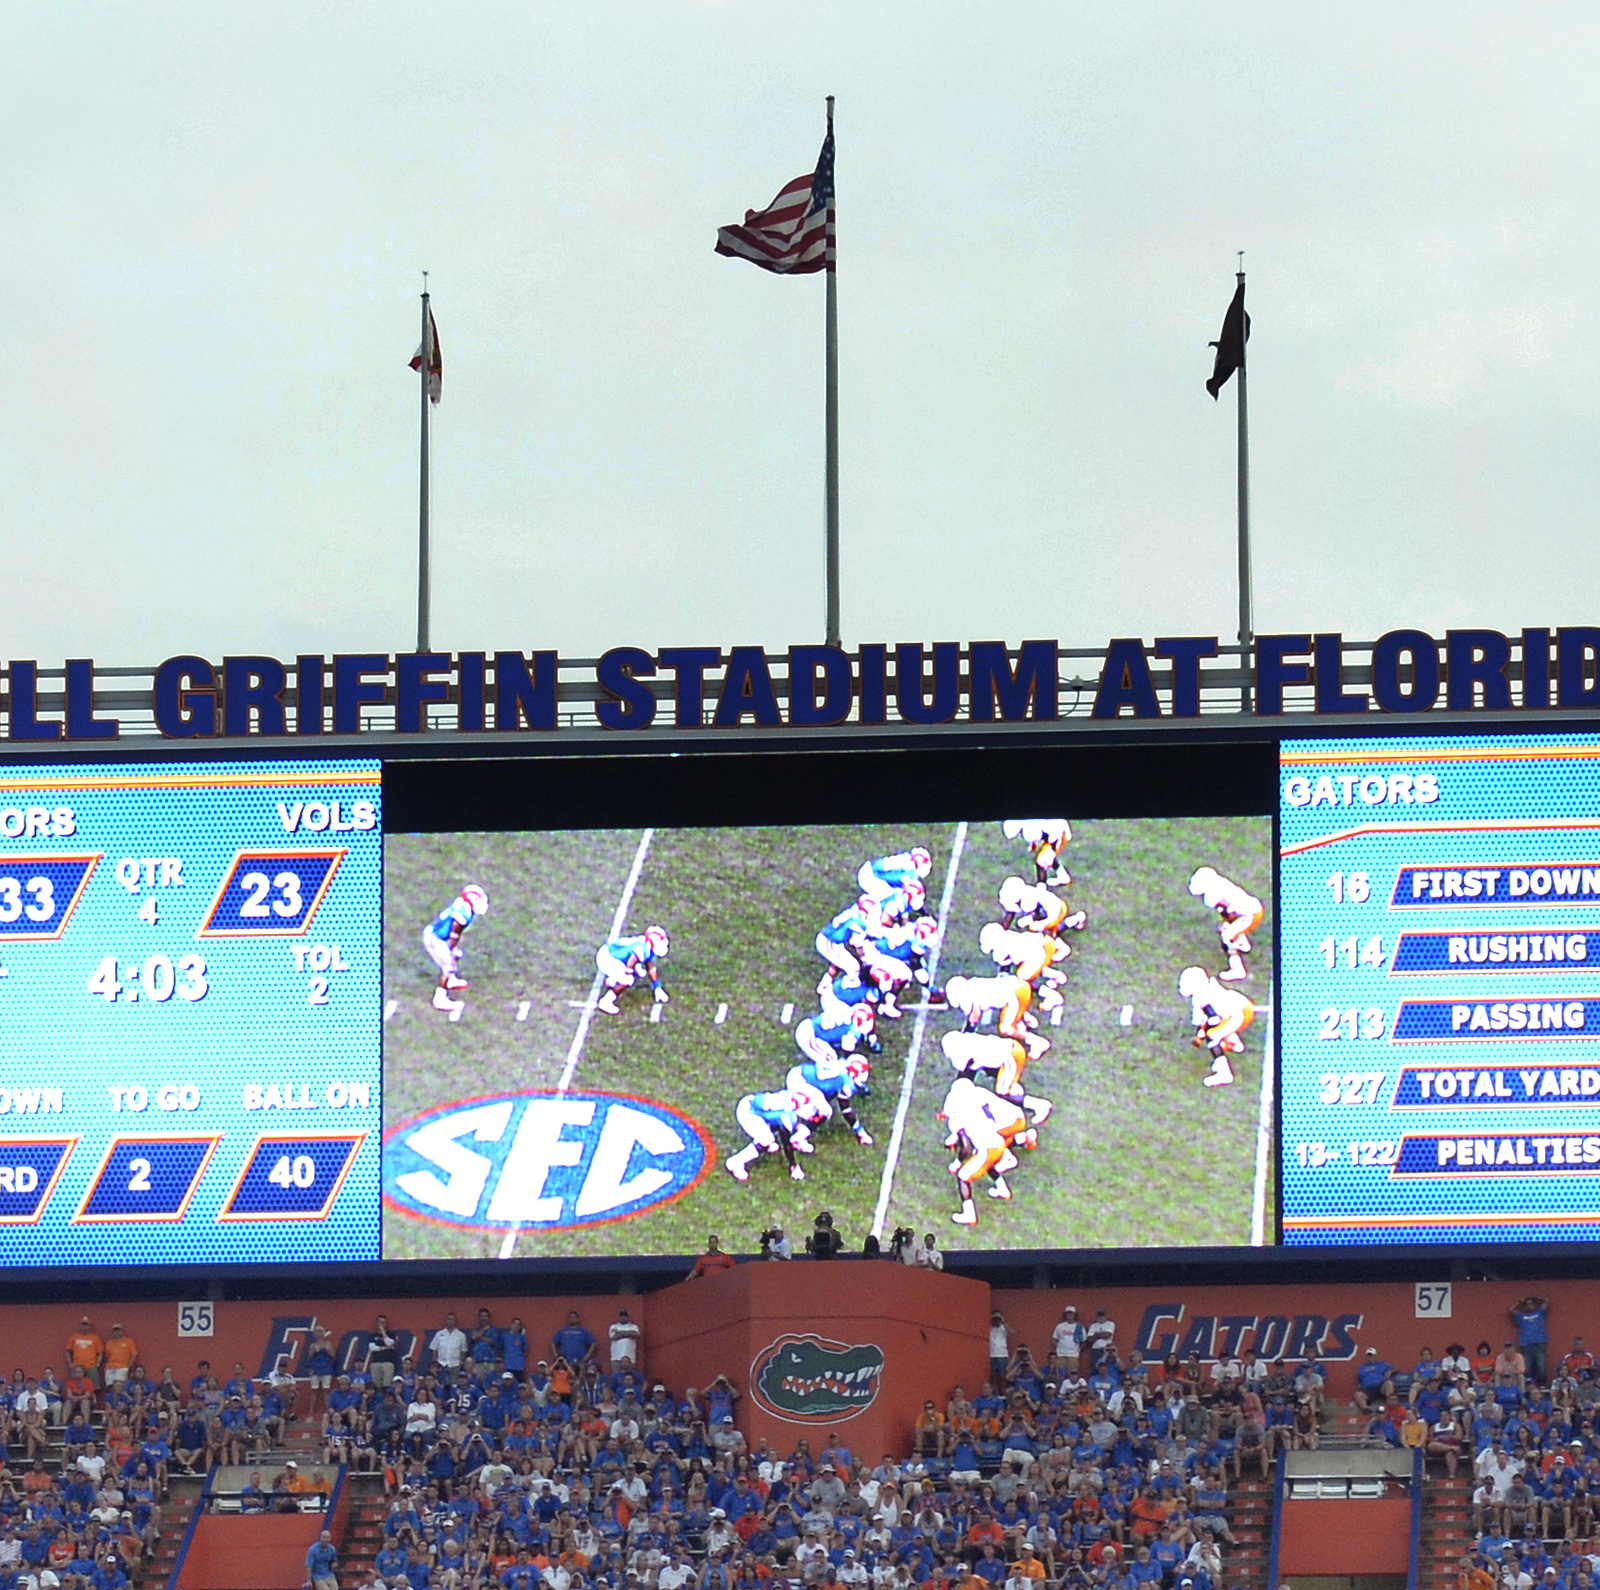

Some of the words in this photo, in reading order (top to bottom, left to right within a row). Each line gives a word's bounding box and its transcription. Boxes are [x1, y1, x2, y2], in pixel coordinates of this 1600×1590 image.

[152, 649, 559, 741] GRIFFIN
[595, 637, 1061, 732] STADIUM
[1092, 636, 1217, 719] AT
[1283, 774, 1440, 806] GATORS
[277, 801, 378, 832] VOLS
[115, 857, 186, 893] QTR
[1326, 871, 1370, 904] 16
[1410, 870, 1501, 898] FIRST
[239, 871, 304, 918] 23
[137, 898, 161, 925] 4
[290, 944, 350, 972] TOL
[1318, 936, 1387, 970] 114
[1447, 935, 1588, 964] RUSHING
[87, 953, 210, 1002] 4:03
[307, 976, 329, 1005] 2
[1318, 1007, 1387, 1041] 213
[1450, 1001, 1586, 1032] PASSING
[108, 1084, 149, 1113] TO
[157, 1084, 202, 1112] GO
[243, 1083, 319, 1111] BALL
[326, 1081, 372, 1109] ON
[1318, 1072, 1387, 1106] 327
[1415, 1070, 1514, 1099] TOTAL
[128, 1158, 152, 1191] 2
[268, 1154, 316, 1190] 40
[393, 1099, 688, 1223] SEC
[1417, 1286, 1450, 1312] 57
[180, 1305, 213, 1332] 55
[1133, 1302, 1364, 1365] GATORS
[456, 1393, 471, 1408] 15
